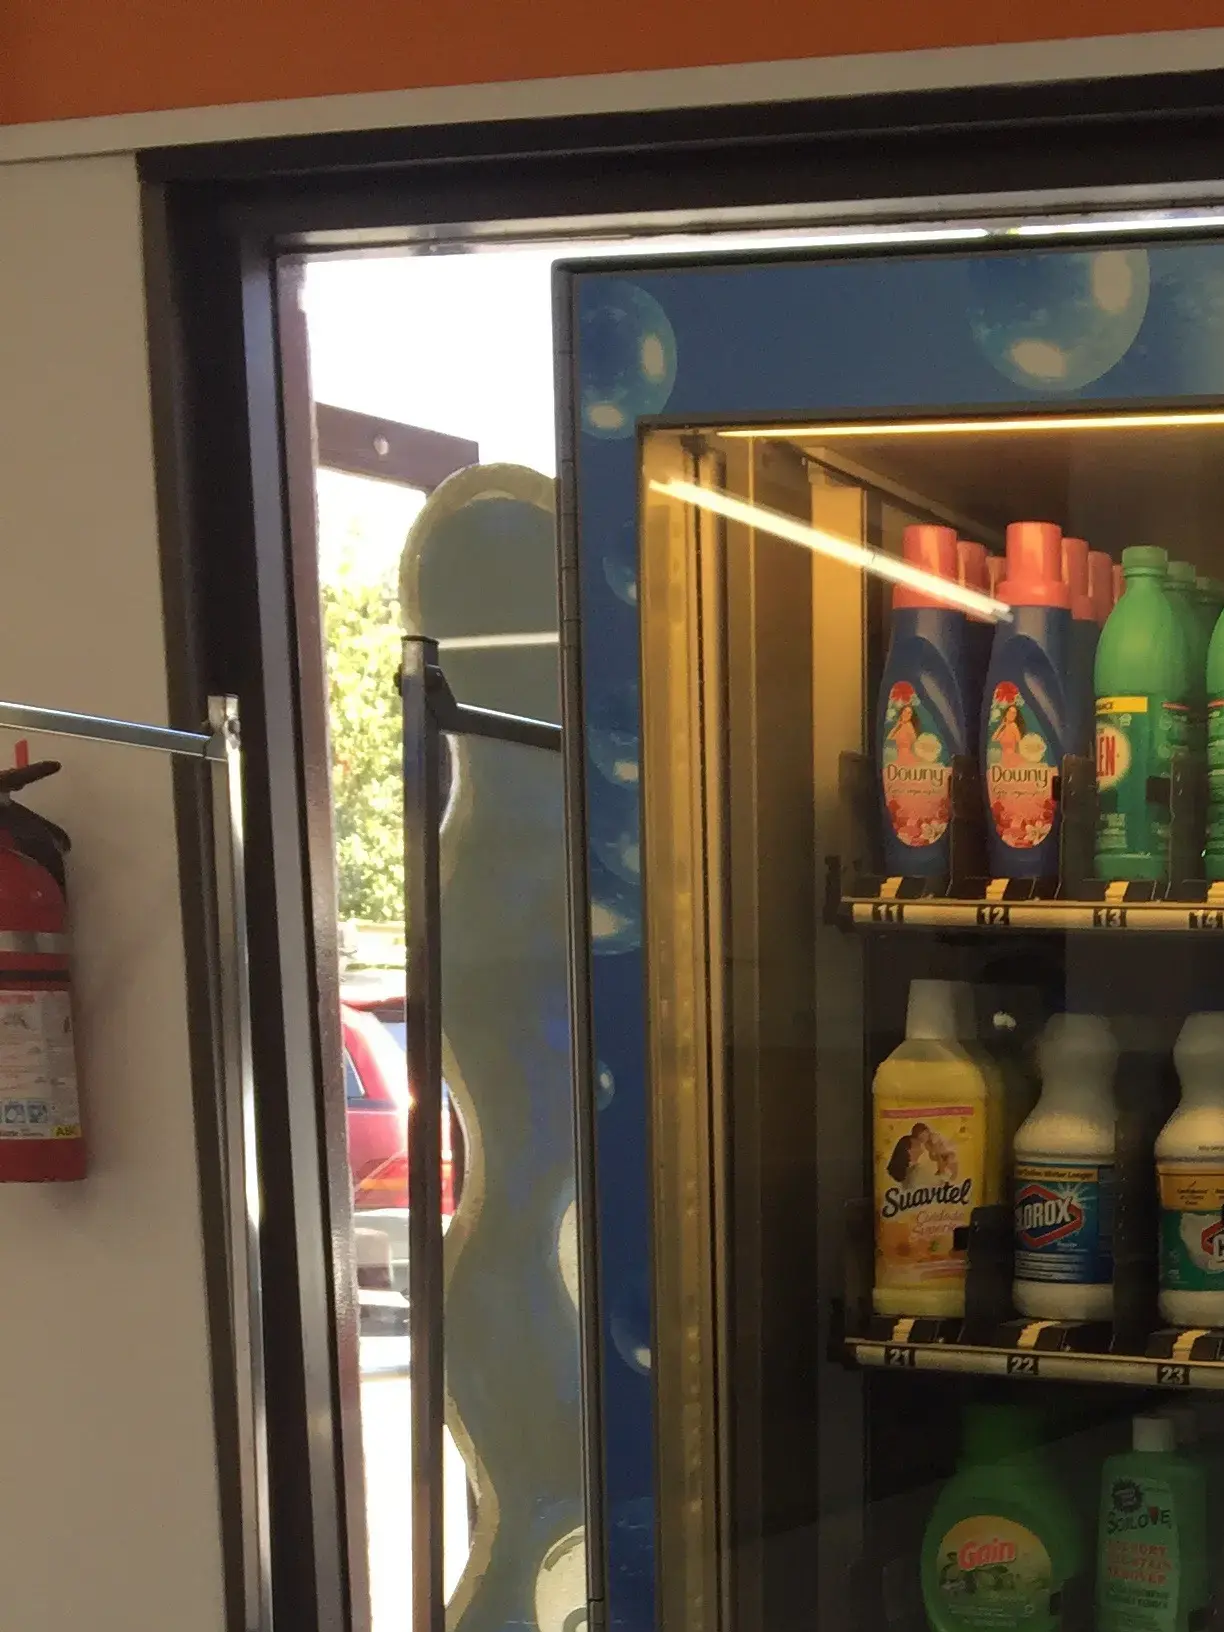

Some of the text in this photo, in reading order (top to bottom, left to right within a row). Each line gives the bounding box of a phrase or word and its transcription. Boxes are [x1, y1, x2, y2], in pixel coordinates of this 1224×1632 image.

[886, 764, 946, 787] Downy
[991, 765, 1049, 788] Downy
[878, 904, 900, 922] 11
[981, 906, 1005, 925] 12
[1099, 908, 1122, 928] 13
[1196, 909, 1220, 929] 14
[881, 1178, 972, 1218] Suavitel
[888, 1347, 911, 1366] 21
[1010, 1356, 1036, 1374] 22
[1160, 1365, 1185, 1385] 23
[959, 1537, 1017, 1571] Gain
